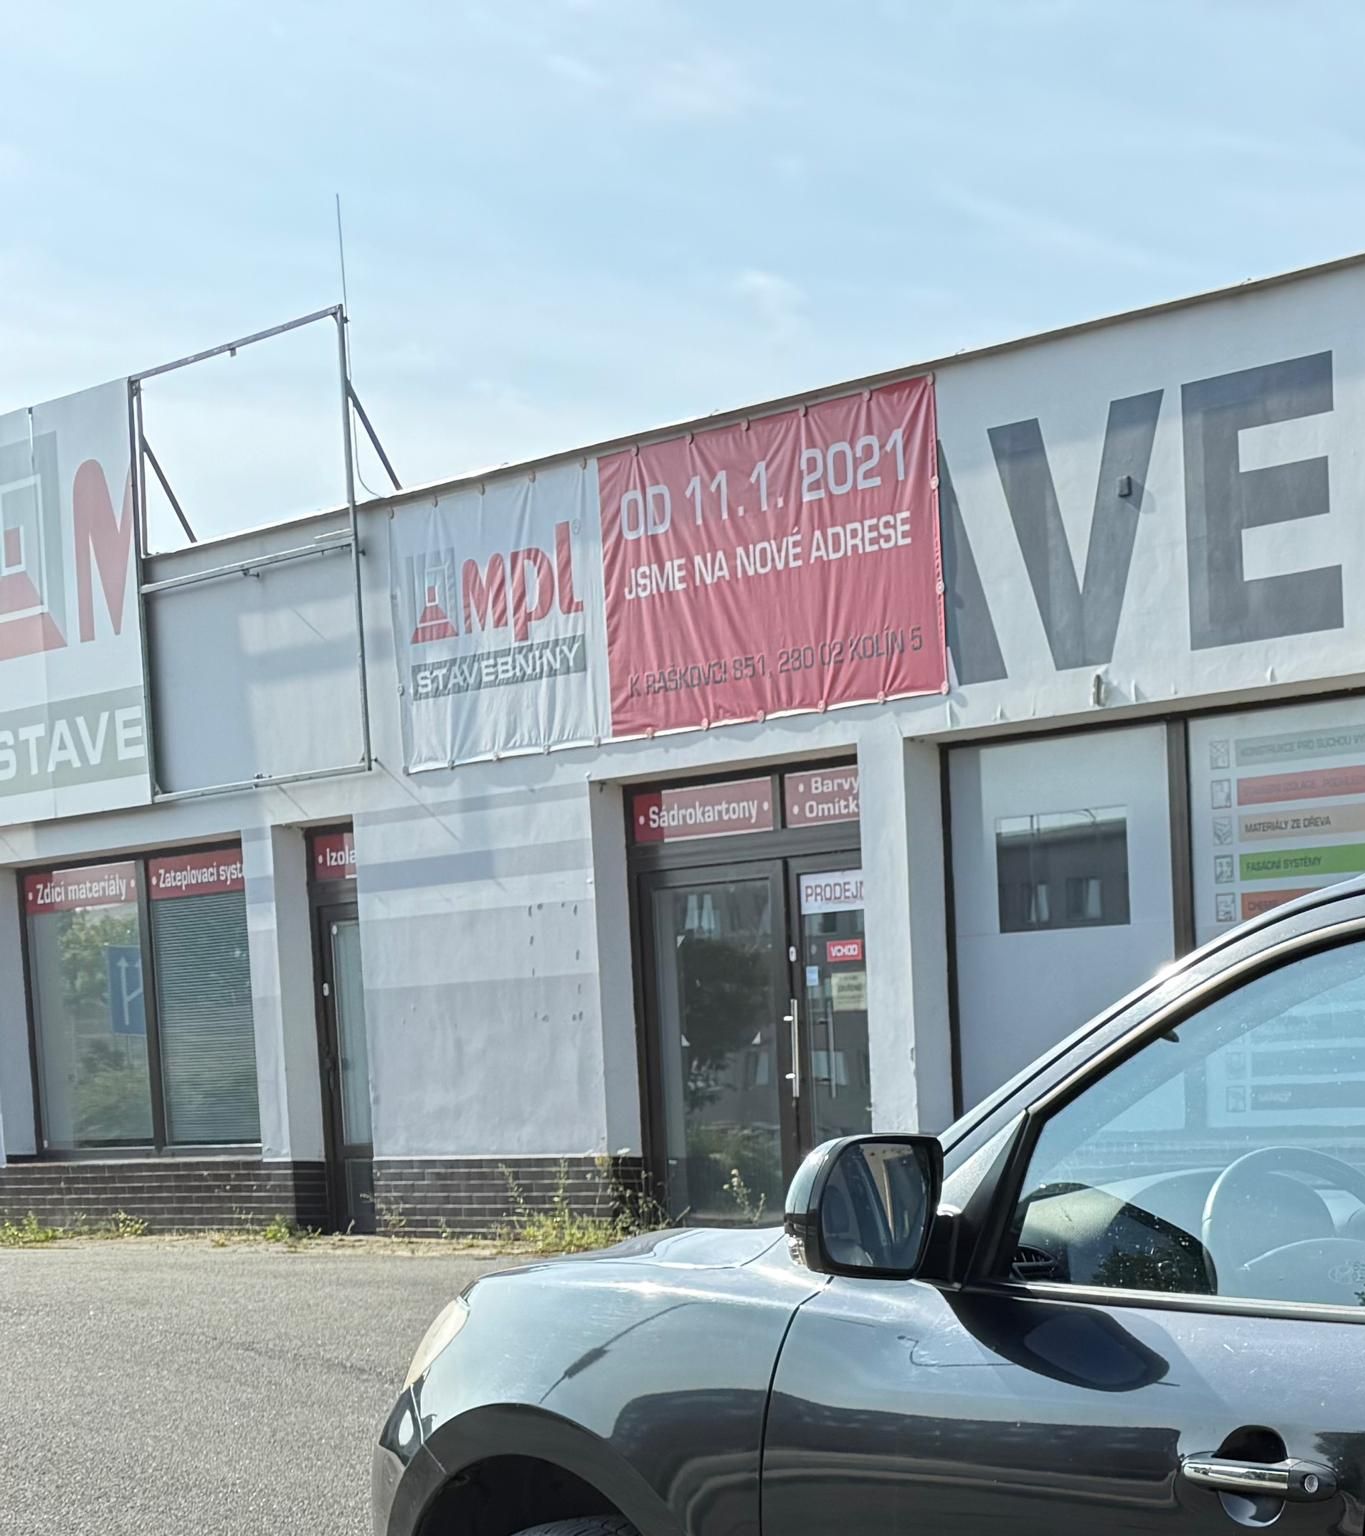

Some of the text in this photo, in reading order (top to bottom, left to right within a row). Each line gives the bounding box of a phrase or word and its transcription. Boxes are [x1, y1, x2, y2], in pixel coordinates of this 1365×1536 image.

[621, 485, 672, 540] OD
[800, 428, 905, 502] 2021
[624, 511, 912, 600] JSME NA NOVÉ ADRESE
[416, 641, 580, 693] STAVEBNINY
[628, 672, 641, 698] K
[778, 645, 815, 674] 280
[819, 640, 845, 667] 02
[849, 625, 905, 663] KOLÍN
[910, 626, 923, 651] 5
[811, 776, 860, 794] Barvy
[649, 797, 758, 829] Sádrokartony
[805, 796, 860, 818] Omítk
[1244, 815, 1332, 834] MATERIÁLY ZE DŘEVA
[36, 873, 127, 905] Zdící materiály
[158, 860, 244, 891] Zateplovací syst
